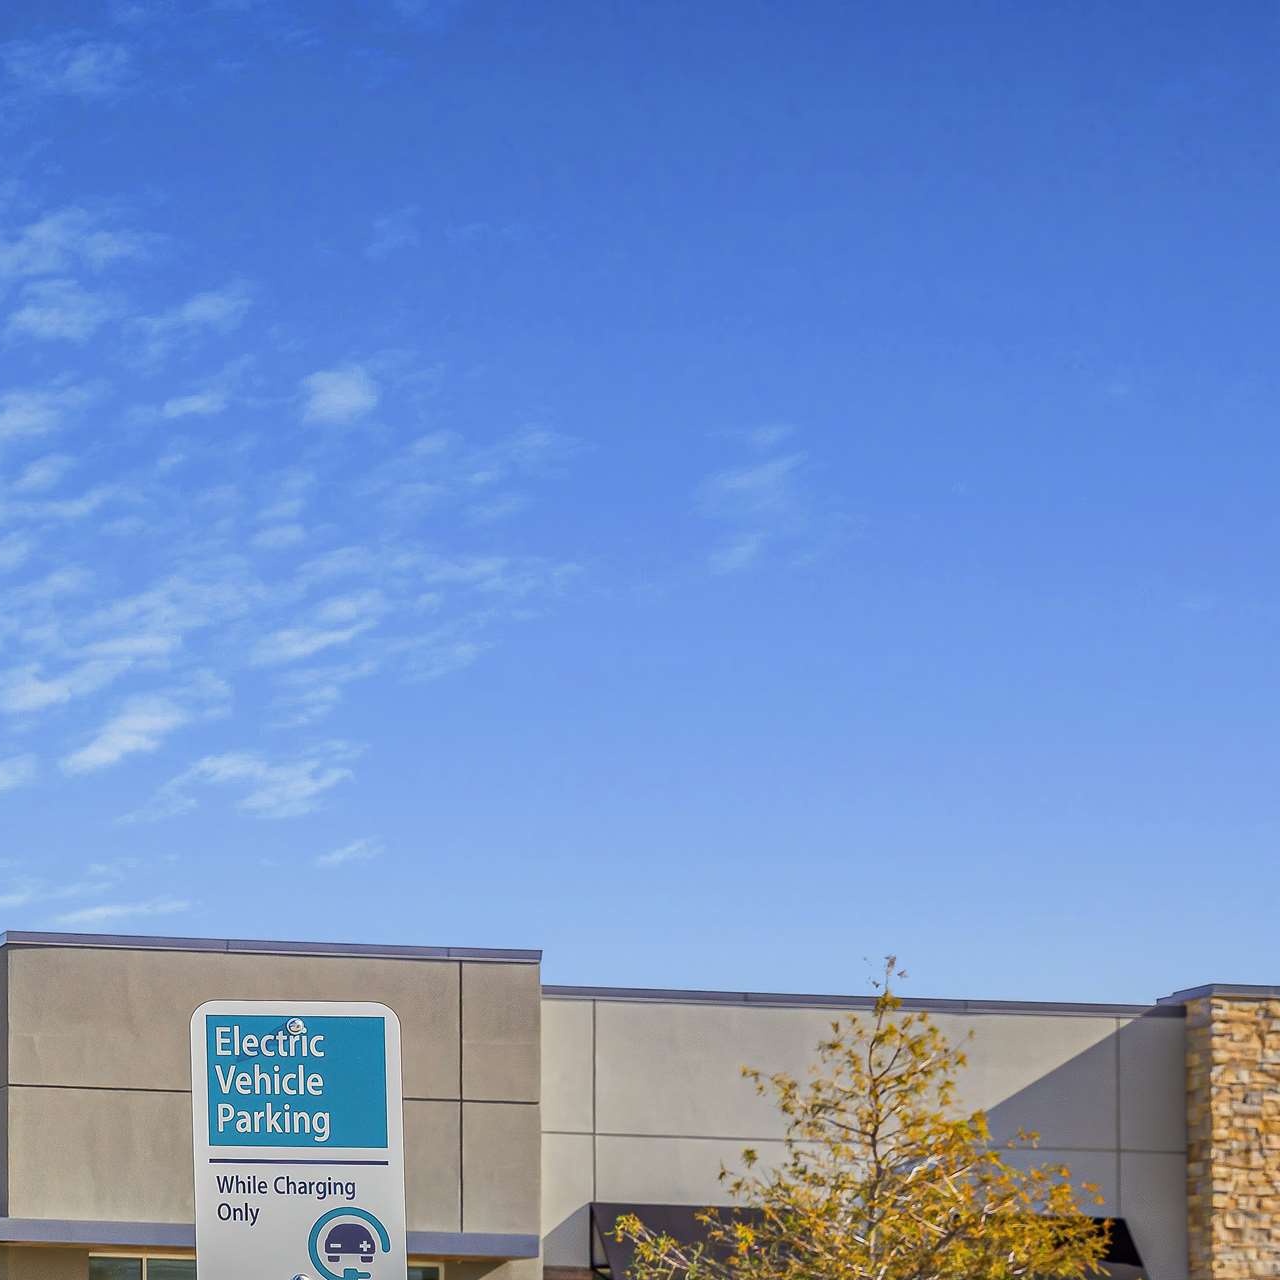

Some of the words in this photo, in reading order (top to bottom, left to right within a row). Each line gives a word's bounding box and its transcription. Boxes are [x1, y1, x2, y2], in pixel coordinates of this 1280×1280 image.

[215, 1025, 325, 1057] Electric
[215, 1064, 324, 1096] Vehicle
[216, 1103, 331, 1142] Parking
[216, 1175, 268, 1194] While
[273, 1175, 356, 1200] Charging
[217, 1202, 260, 1226] Only
